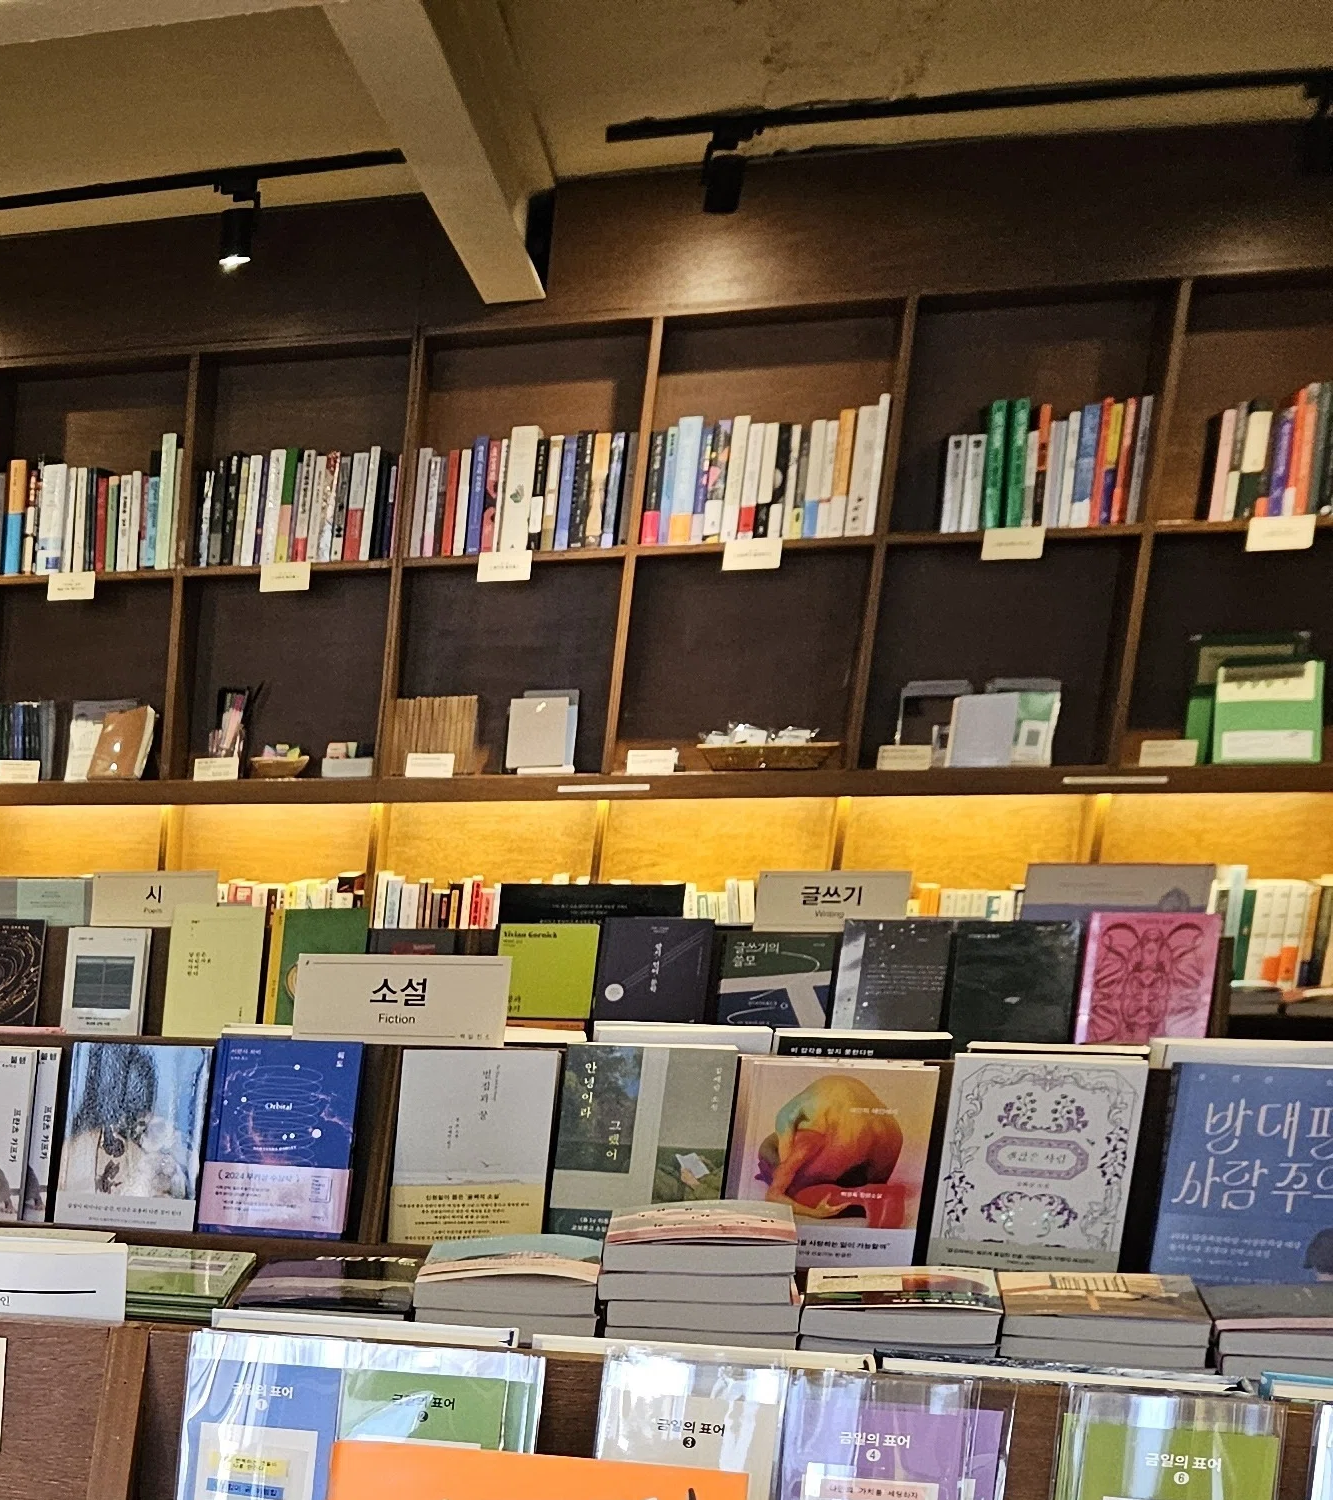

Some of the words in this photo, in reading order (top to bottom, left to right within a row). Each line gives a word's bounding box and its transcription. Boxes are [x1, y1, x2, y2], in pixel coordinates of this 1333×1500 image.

[146, 885, 162, 903] 시
[801, 886, 863, 906] 글쓰기
[528, 931, 557, 939] Gornick
[734, 941, 779, 955] 글쓰기의
[734, 955, 756, 969] 쓸모
[370, 978, 427, 1006] 소설
[378, 1013, 415, 1024] Fiction
[265, 1102, 292, 1111] Orbital
[580, 1061, 598, 1118] 안녕이라
[606, 1120, 622, 1161] 그랬어
[11, 1109, 21, 1134] 프란츠
[42, 1106, 53, 1131] 프란츠
[9, 1138, 19, 1163] 카프카
[39, 1135, 50, 1160] 카프카
[700, 1422, 726, 1437] 표어
[838, 1431, 880, 1447] 금일의
[882, 1434, 911, 1449] 표어
[1144, 1453, 1188, 1470] 금일의
[1191, 1456, 1223, 1473] 표어
